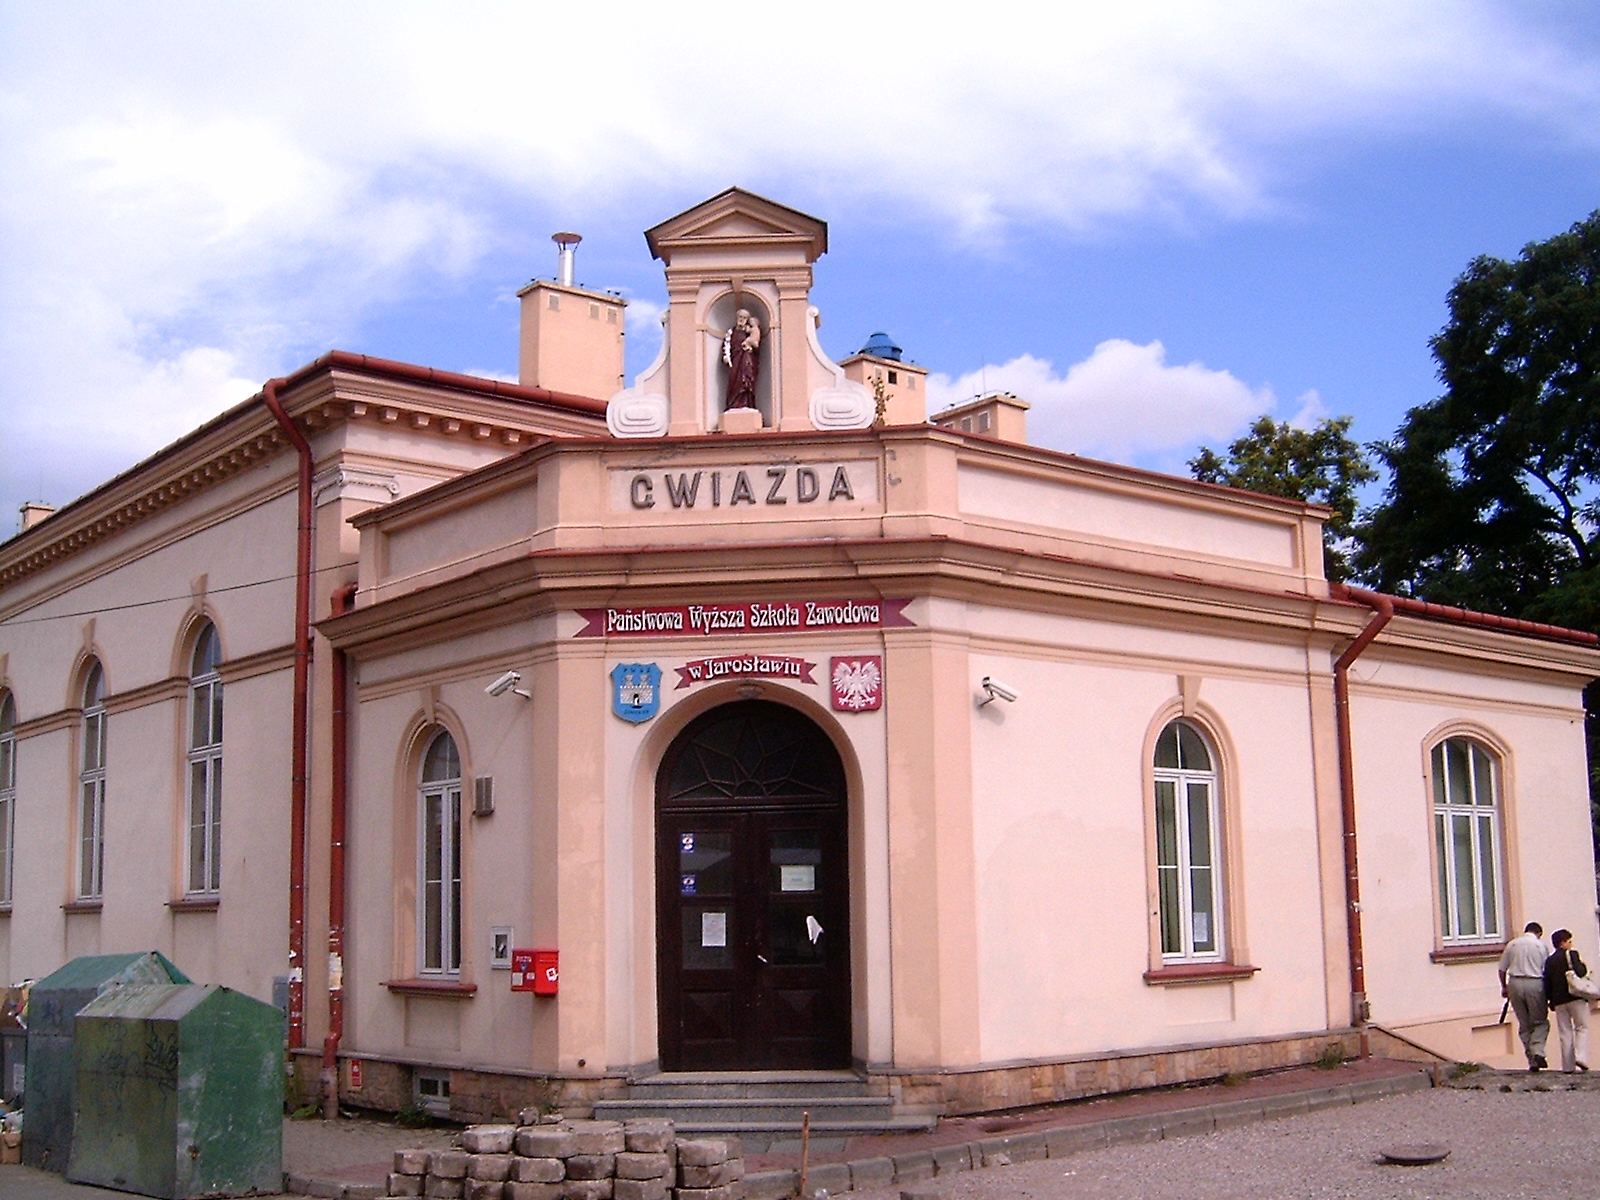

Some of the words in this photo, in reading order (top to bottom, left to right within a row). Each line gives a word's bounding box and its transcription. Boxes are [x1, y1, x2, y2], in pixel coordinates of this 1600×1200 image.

[630, 465, 855, 509] GWIAZDA
[607, 608, 683, 632] Państwowa
[688, 605, 745, 634] Wyższa
[750, 603, 799, 628] Szkoła
[805, 601, 880, 626] Zawodowa
[689, 665, 702, 679] w
[704, 656, 801, 679] Jarosławiu
